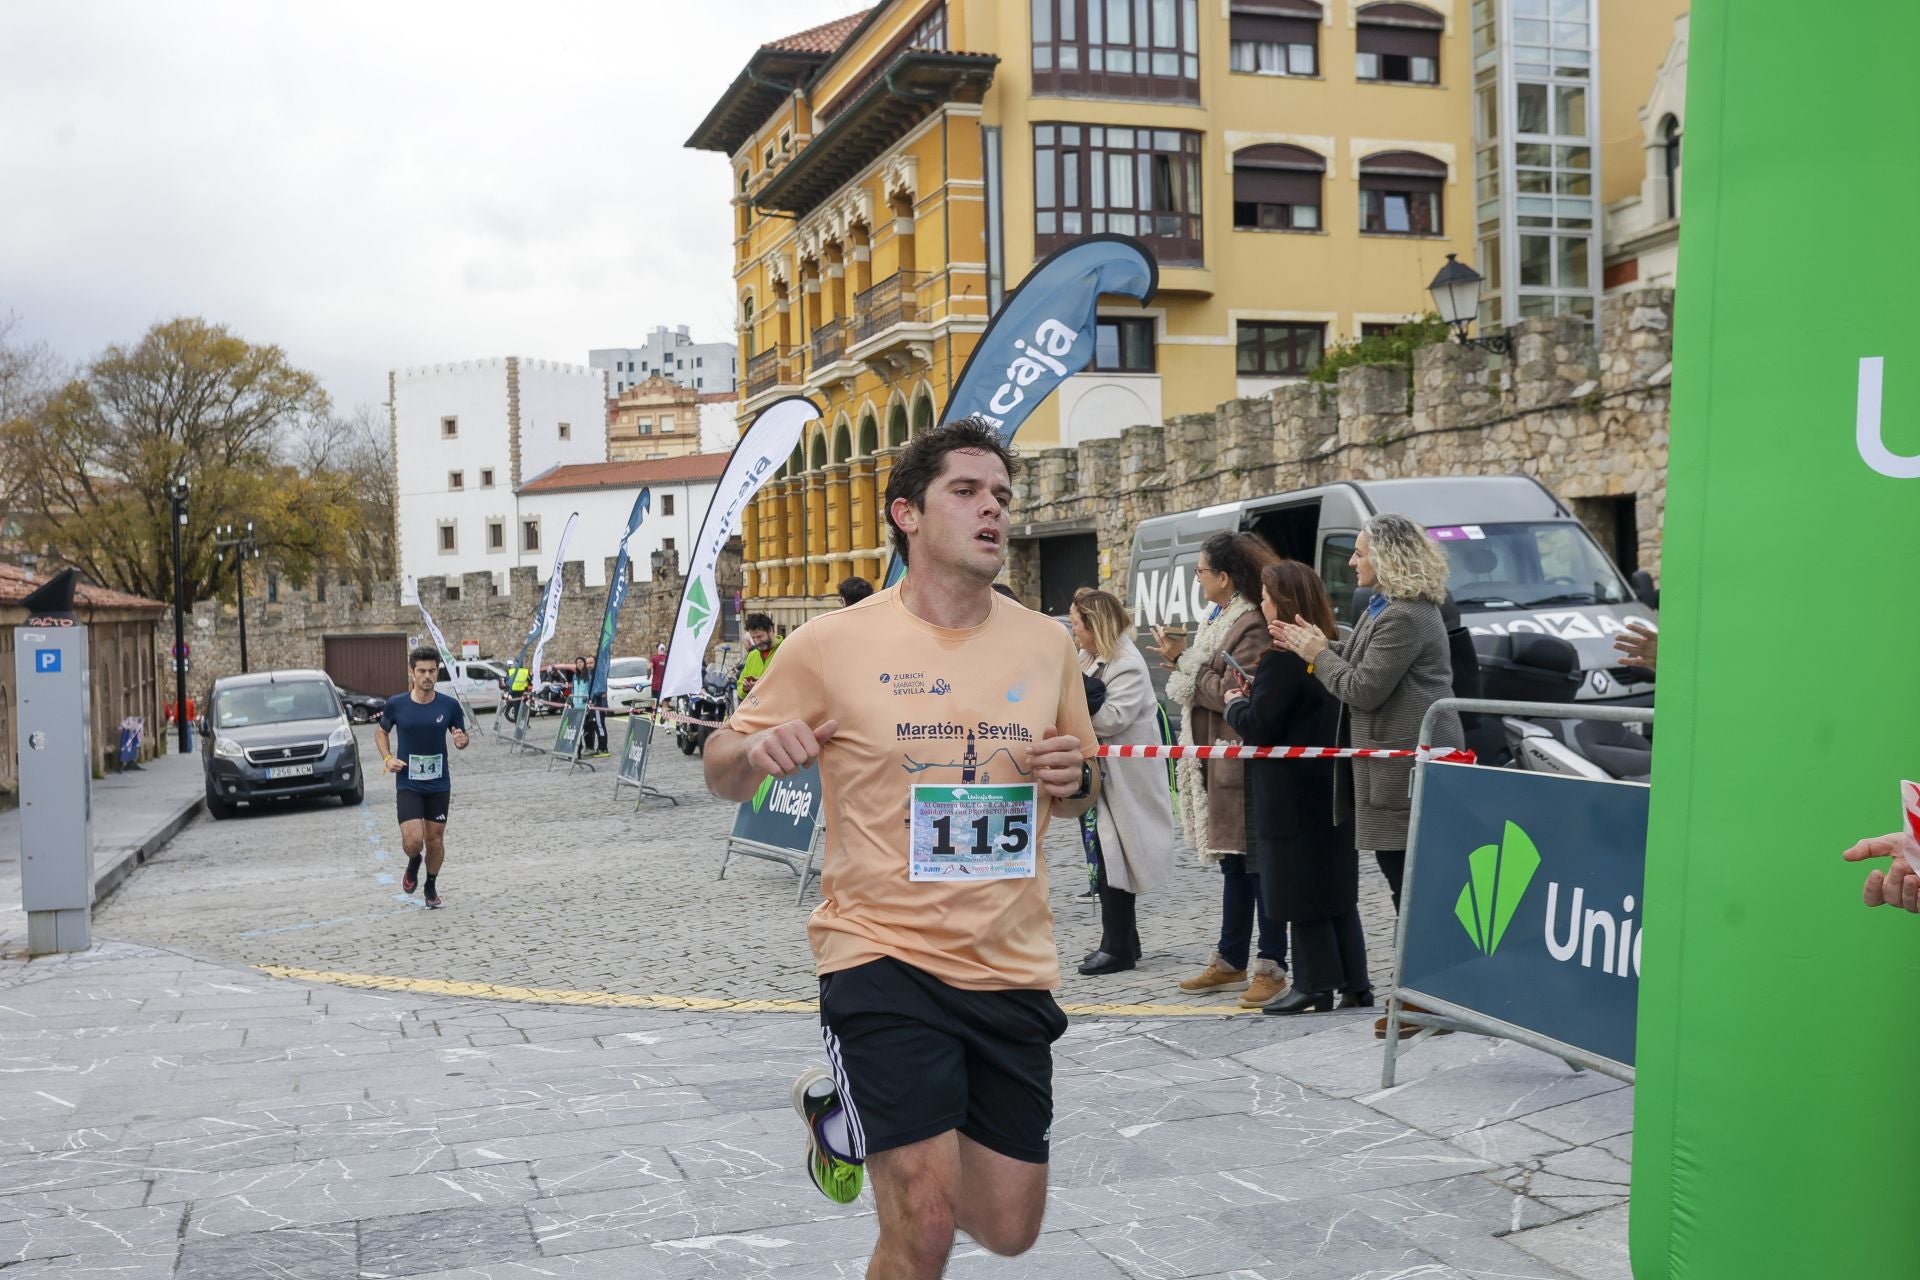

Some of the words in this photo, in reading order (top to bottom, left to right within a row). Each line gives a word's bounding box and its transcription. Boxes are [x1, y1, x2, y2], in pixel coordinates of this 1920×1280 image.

[42, 652, 56, 668] P
[893, 672, 924, 681] ZURICH
[893, 687, 926, 696] SEVILLA
[896, 721, 964, 737] Maratón
[419, 762, 437, 774] 14
[769, 780, 813, 826] Unicaja
[932, 815, 1029, 855] 115
[1544, 882, 1643, 978] Uni
